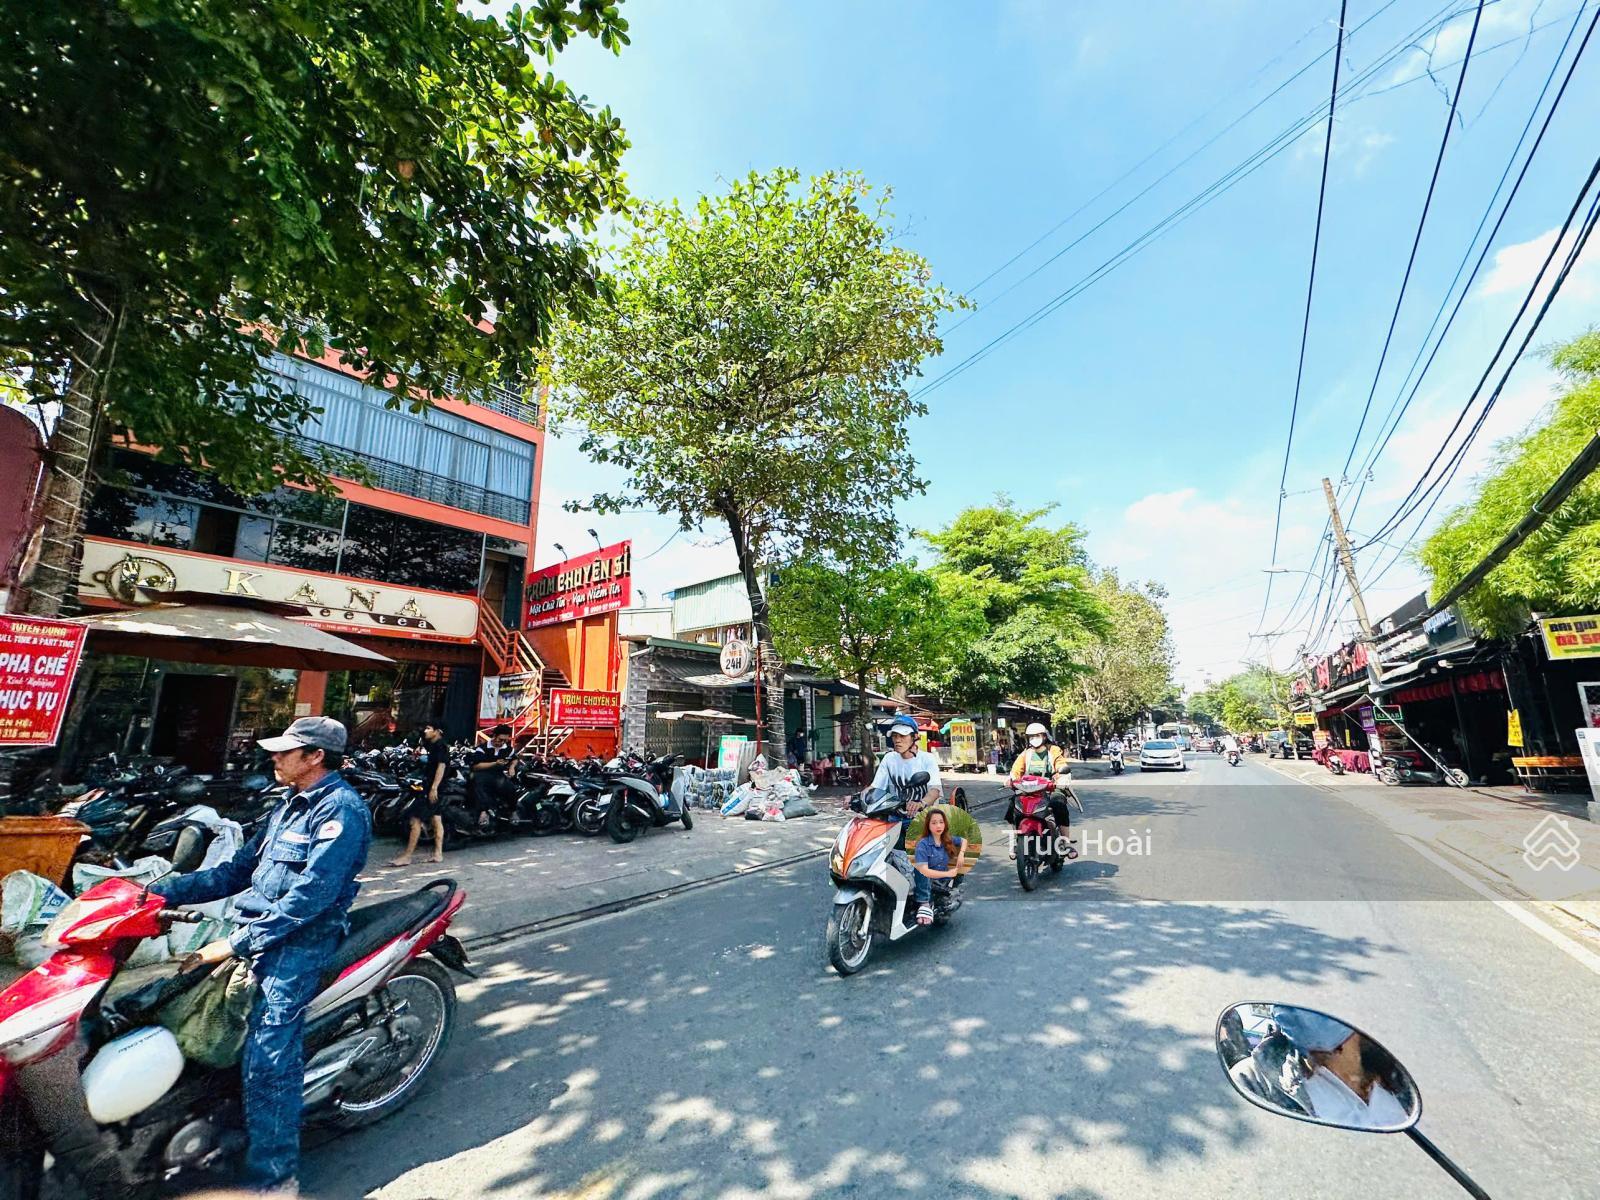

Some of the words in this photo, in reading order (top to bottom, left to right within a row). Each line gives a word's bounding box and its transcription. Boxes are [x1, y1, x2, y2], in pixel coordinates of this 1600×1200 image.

[557, 557, 612, 592] CHUYÊN
[219, 568, 427, 619] KANA
[379, 615, 427, 629] tea
[14, 635, 32, 643] TIME
[39, 637, 57, 647] PART
[58, 639, 75, 648] TIME
[0, 652, 31, 674] PHA
[34, 650, 71, 676] CHẾ
[726, 657, 742, 670] 24H
[0, 689, 32, 715] HỤC
[36, 691, 59, 717] VỤ
